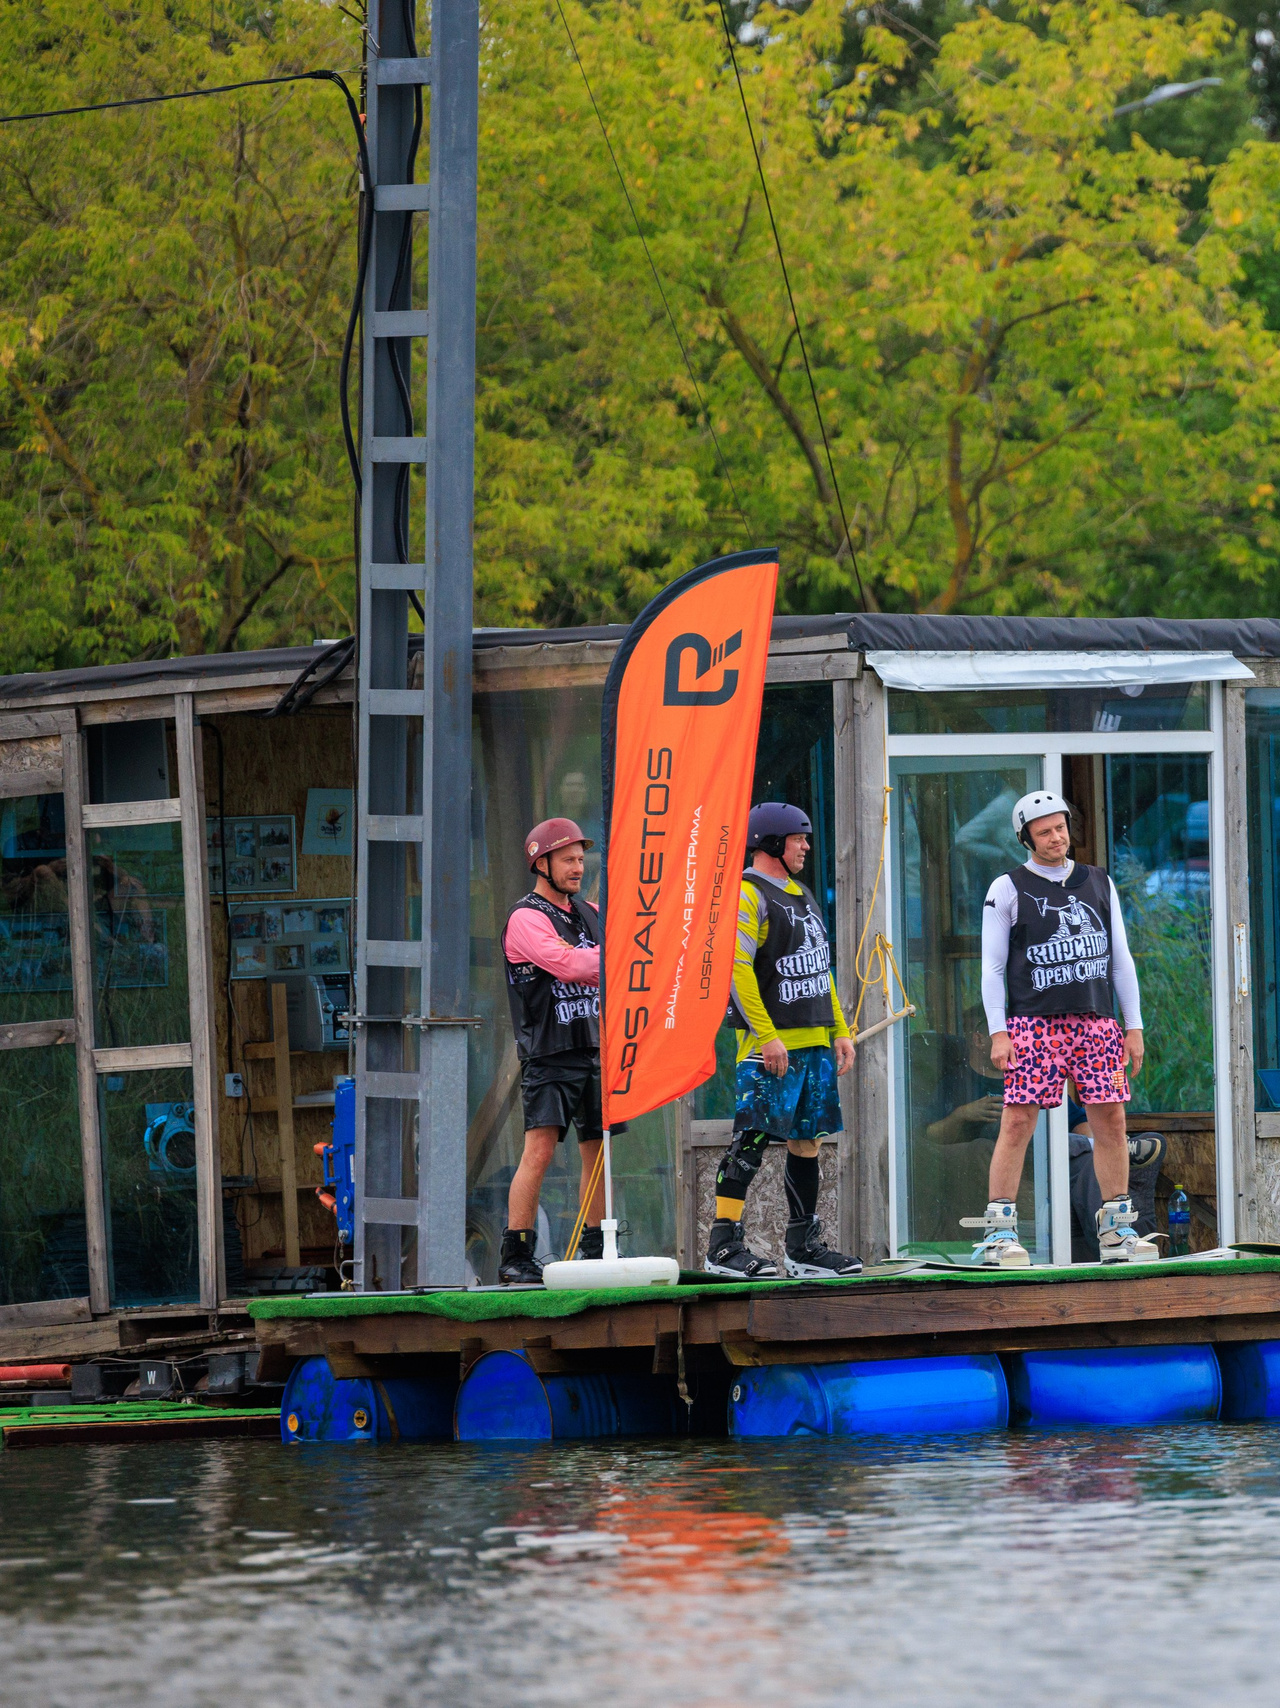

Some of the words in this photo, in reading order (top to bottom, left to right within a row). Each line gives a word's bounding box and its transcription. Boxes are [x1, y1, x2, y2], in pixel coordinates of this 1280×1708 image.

[628, 747, 673, 992] RAKETOS
[699, 825, 730, 1000] LOSRAKETOS.COM
[664, 953, 685, 1029] ЗАЩИТА
[684, 805, 703, 904] ЭКСТРИМА
[556, 999, 590, 1024] OPEN
[780, 978, 816, 1003] OPEN
[1032, 965, 1073, 990] OPEN
[611, 1006, 649, 1095] LOS
